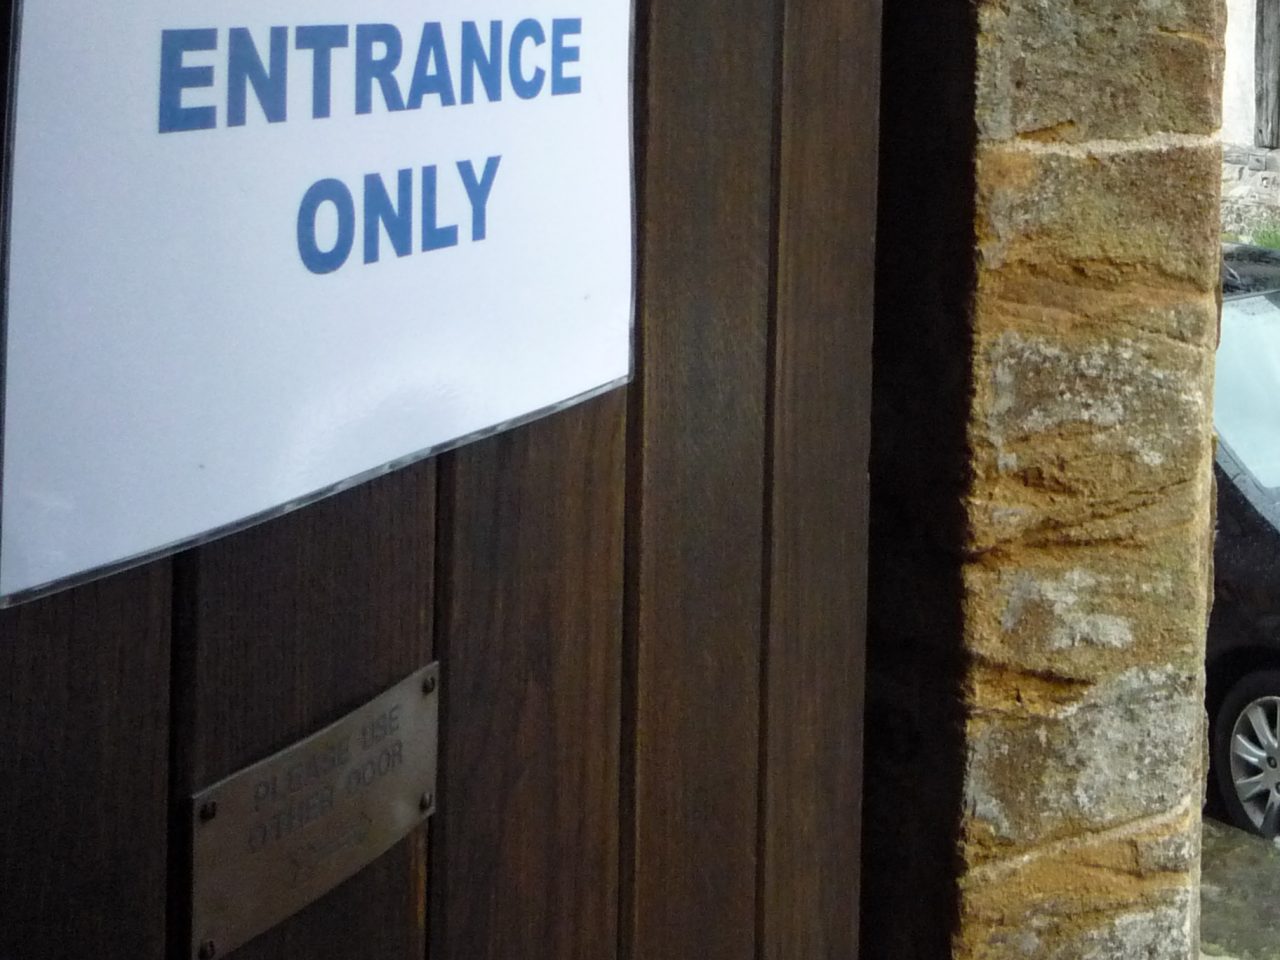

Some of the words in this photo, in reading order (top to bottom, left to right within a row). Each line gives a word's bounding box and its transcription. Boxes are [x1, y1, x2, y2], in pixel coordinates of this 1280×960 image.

[158, 17, 582, 134] ENTRANCE
[296, 155, 502, 275] ONLY
[253, 736, 351, 811] PLEASE
[361, 704, 401, 750] USE
[346, 740, 404, 795] DOOR
